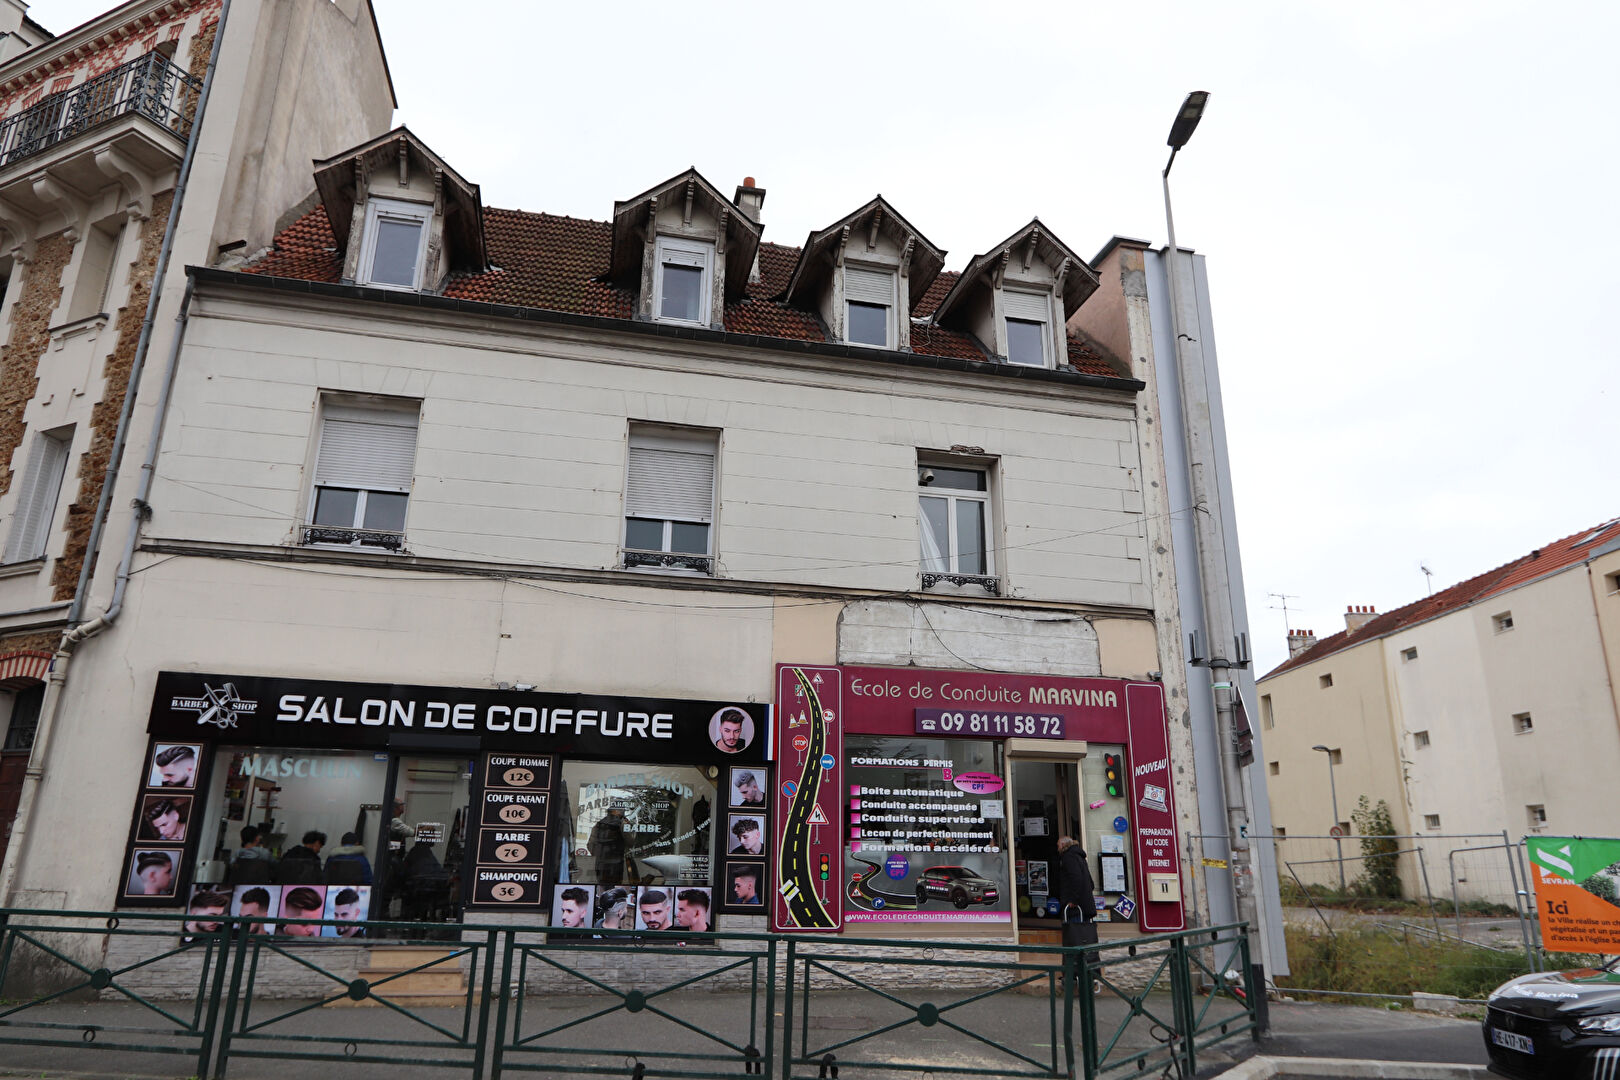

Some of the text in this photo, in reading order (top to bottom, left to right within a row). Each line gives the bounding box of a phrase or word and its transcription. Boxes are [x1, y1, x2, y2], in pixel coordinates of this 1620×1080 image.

[851, 678, 1117, 707] Ecole de Conduite MARVINA
[171, 700, 258, 711] BARBER SHOP
[276, 694, 674, 738] SALON DE COIFFURE
[940, 712, 1061, 735] 09 81 11 58 72
[239, 756, 363, 778] MASCULIN
[490, 757, 549, 767] COUPE HOMME
[851, 757, 953, 768] FORMATIONS PERMIS
[1135, 758, 1167, 776] NOUVEAU
[509, 772, 531, 781] 12€
[942, 768, 953, 781] B
[585, 773, 694, 799] BARBER SHOP
[486, 793, 546, 804] COUPE ENFANT
[892, 788, 965, 799] automatique
[861, 800, 907, 809] Conduite
[908, 802, 977, 813] accompagnée
[505, 810, 525, 818] 10€
[861, 813, 917, 823] Conduite
[623, 824, 661, 833] BARBE
[1140, 828, 1173, 836] PREPARATION
[495, 833, 531, 842] BARBE
[892, 829, 905, 838] de
[906, 829, 993, 840] perfectionnement
[1146, 838, 1169, 847] AU CODE
[504, 848, 519, 857] 7€
[862, 844, 1000, 853] Formation accélérée
[1153, 849, 1163, 857] PAR
[1148, 859, 1170, 867] INTERNET
[480, 871, 538, 881] SHAMPOING
[1542, 877, 1575, 886] SEVRAN
[499, 887, 515, 896] 3€
[1546, 900, 1569, 915] Ici
[850, 913, 999, 921] WWW.ECOLEDECONDUITEMARVINA.COM
[1576, 917, 1599, 925] réalise
